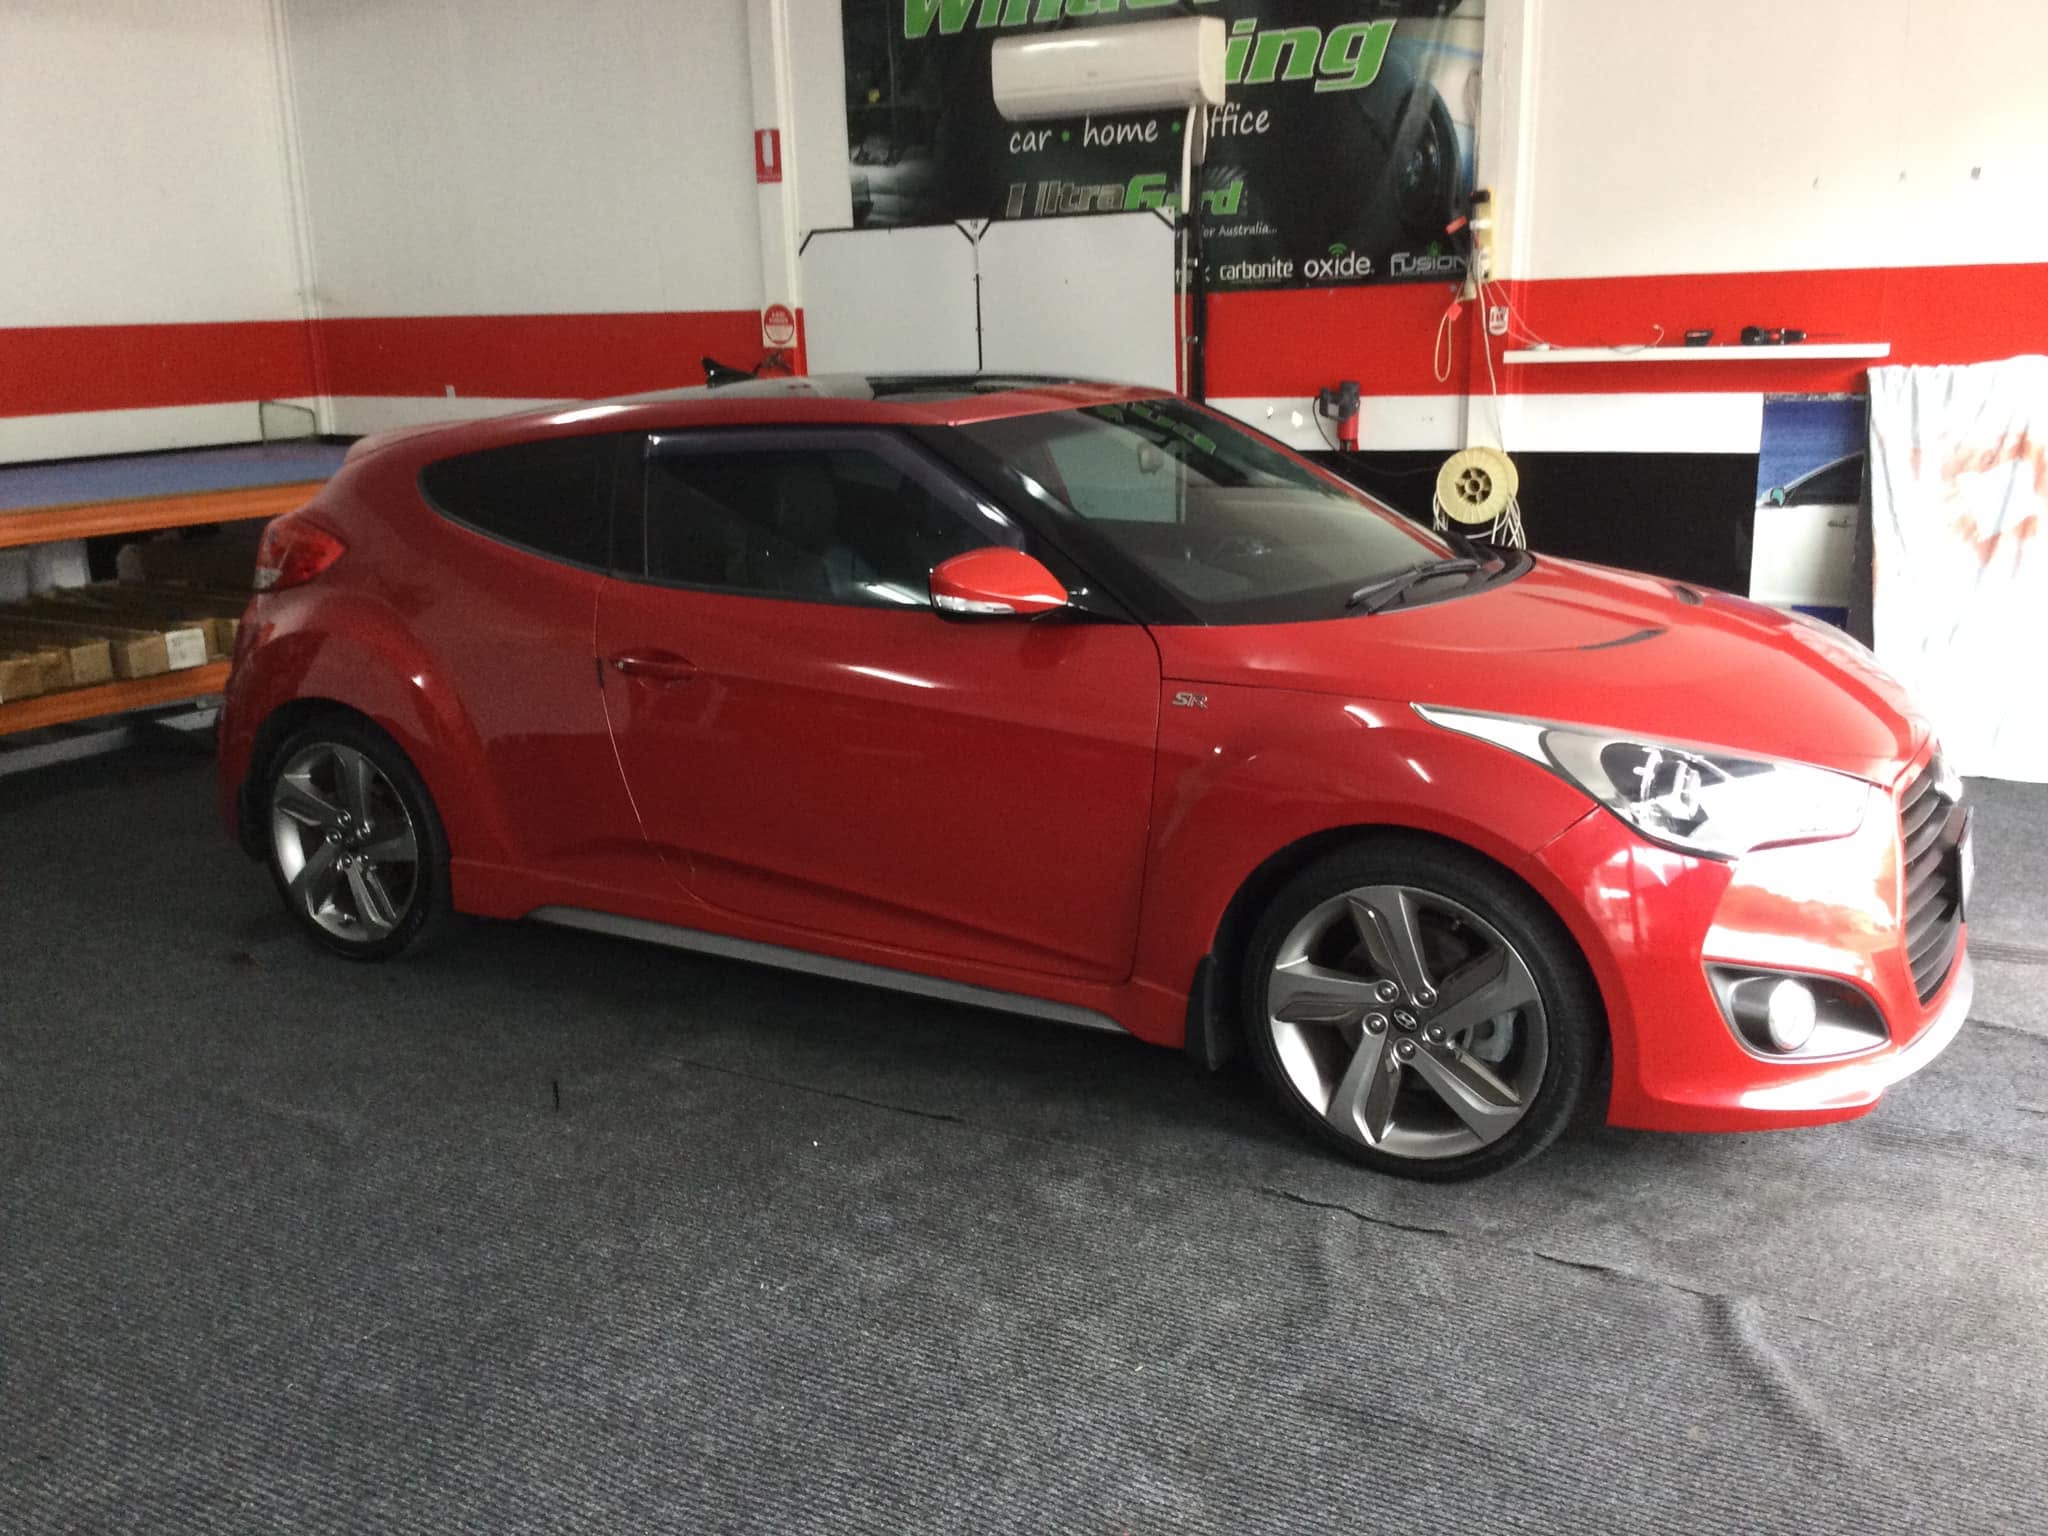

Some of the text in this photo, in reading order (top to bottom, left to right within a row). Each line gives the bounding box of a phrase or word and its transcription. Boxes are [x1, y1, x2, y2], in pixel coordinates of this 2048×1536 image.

[1009, 102, 1271, 153] car home ffice
[1219, 257, 1293, 281] carbonite
[1304, 251, 1371, 278] oxide
